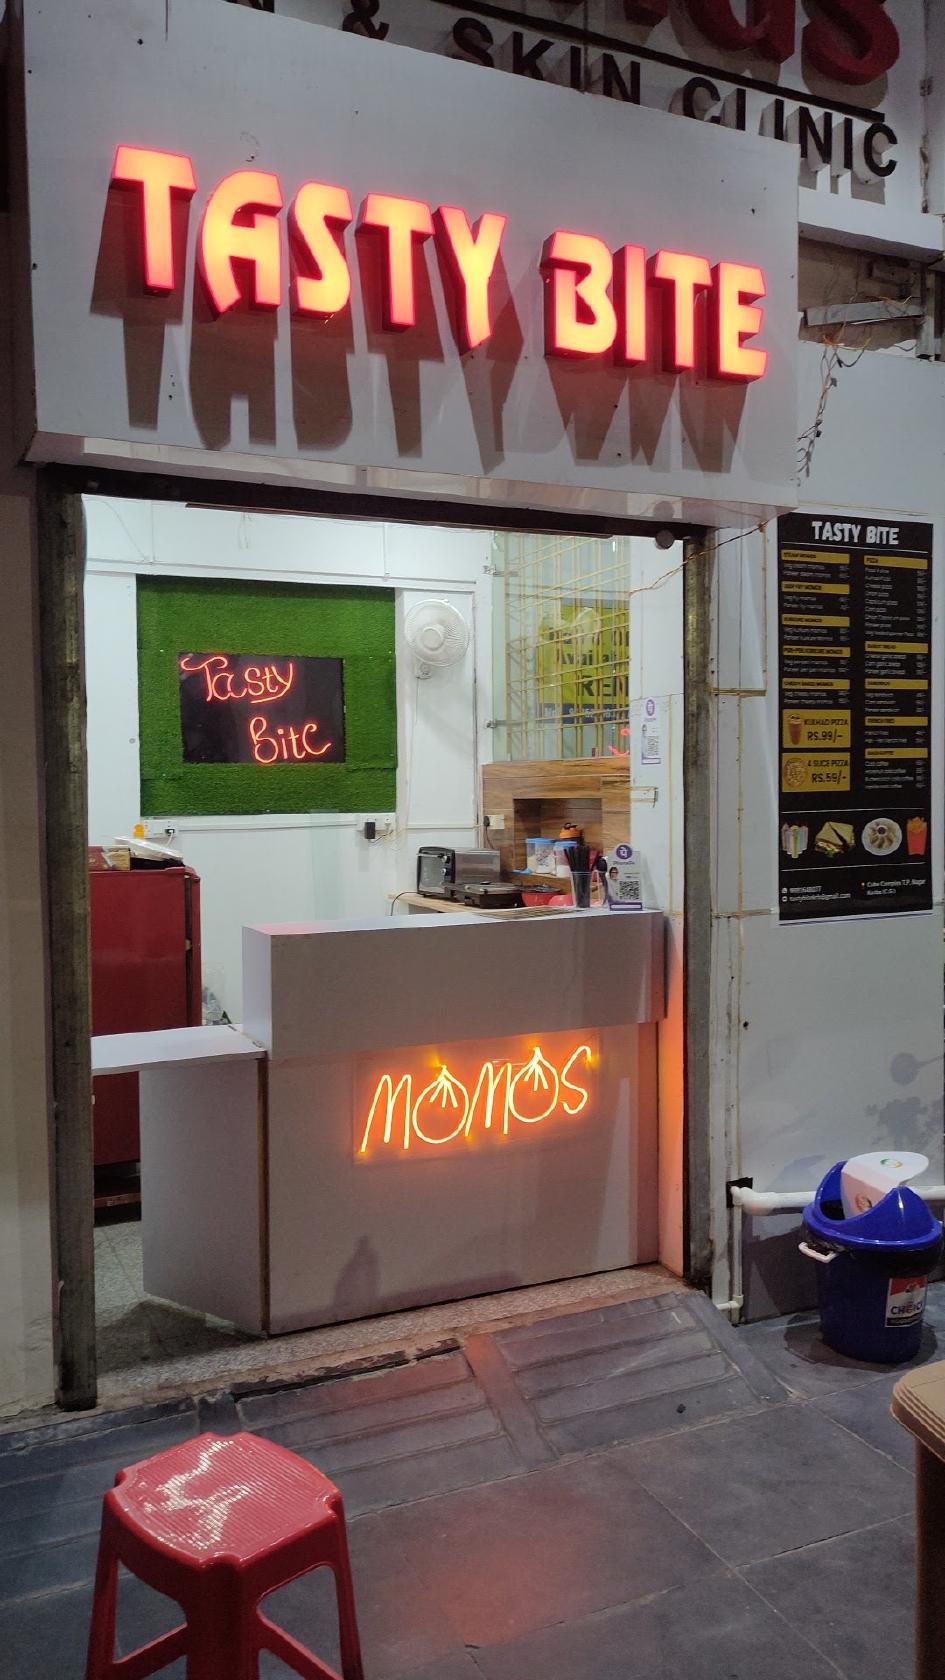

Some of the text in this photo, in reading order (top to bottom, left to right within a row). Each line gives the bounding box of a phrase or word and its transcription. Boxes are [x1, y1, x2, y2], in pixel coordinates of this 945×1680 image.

[453, 17, 641, 106] SKIN
[683, 77, 898, 178] CLINIC
[110, 144, 768, 382] TASTY BITE
[811, 521, 900, 545] TASTY BITE
[180, 656, 293, 704] Tasty
[249, 716, 332, 763] Bite
[360, 1045, 592, 1153] MOMOS
